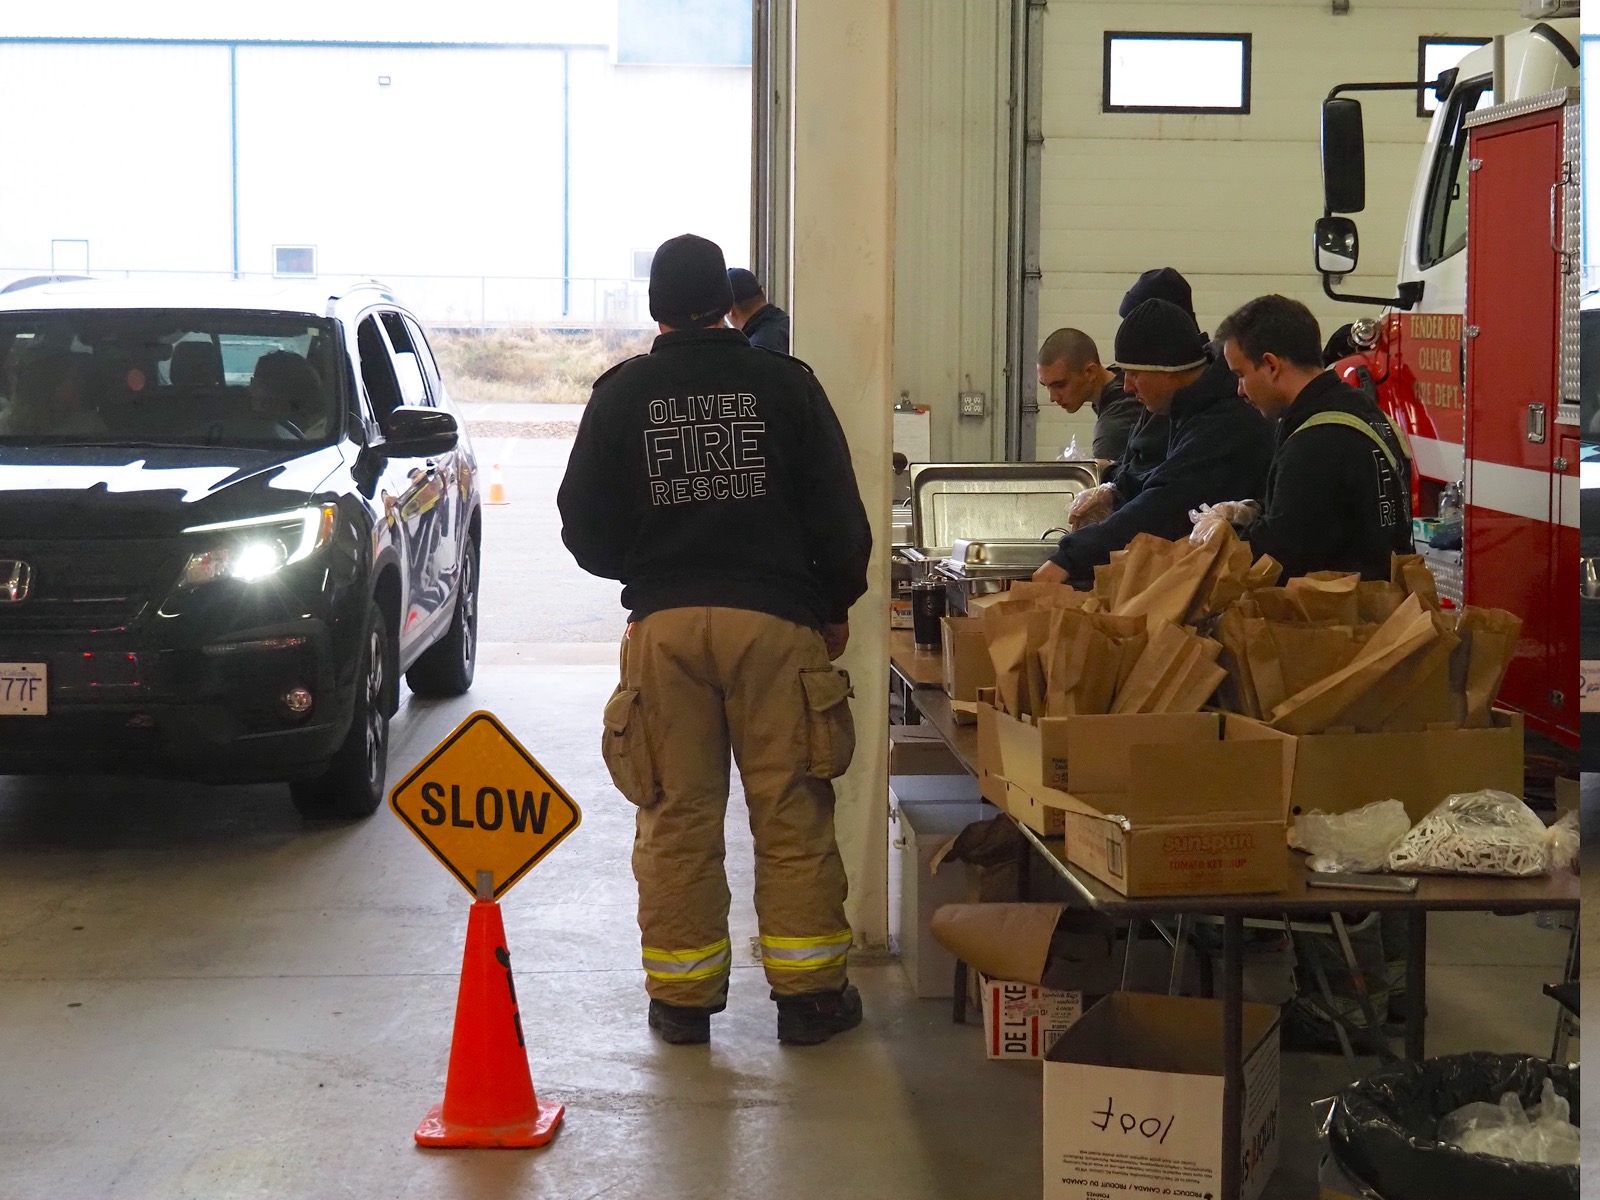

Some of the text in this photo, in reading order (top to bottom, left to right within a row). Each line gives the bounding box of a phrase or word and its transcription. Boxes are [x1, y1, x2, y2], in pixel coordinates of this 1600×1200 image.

[1410, 315, 1461, 341] TENDER 181
[1418, 346, 1453, 373] OLIVER
[649, 392, 757, 424] OLIVER
[1434, 382, 1462, 410] DEPT.
[644, 421, 766, 478] FIRE
[650, 471, 767, 506] RESCUE
[1, 677, 43, 702] 77F
[421, 781, 551, 835] SLOW
[1004, 1032, 1027, 1053] DE
[1061, 1177, 1089, 1187] CANADA
[1089, 1180, 1099, 1188] DU
[1100, 1181, 1128, 1191] PRODUIT
[1133, 1183, 1161, 1194] CANADA
[1162, 1187, 1172, 1195] OF
[1172, 1188, 1203, 1199] PRODUCT
